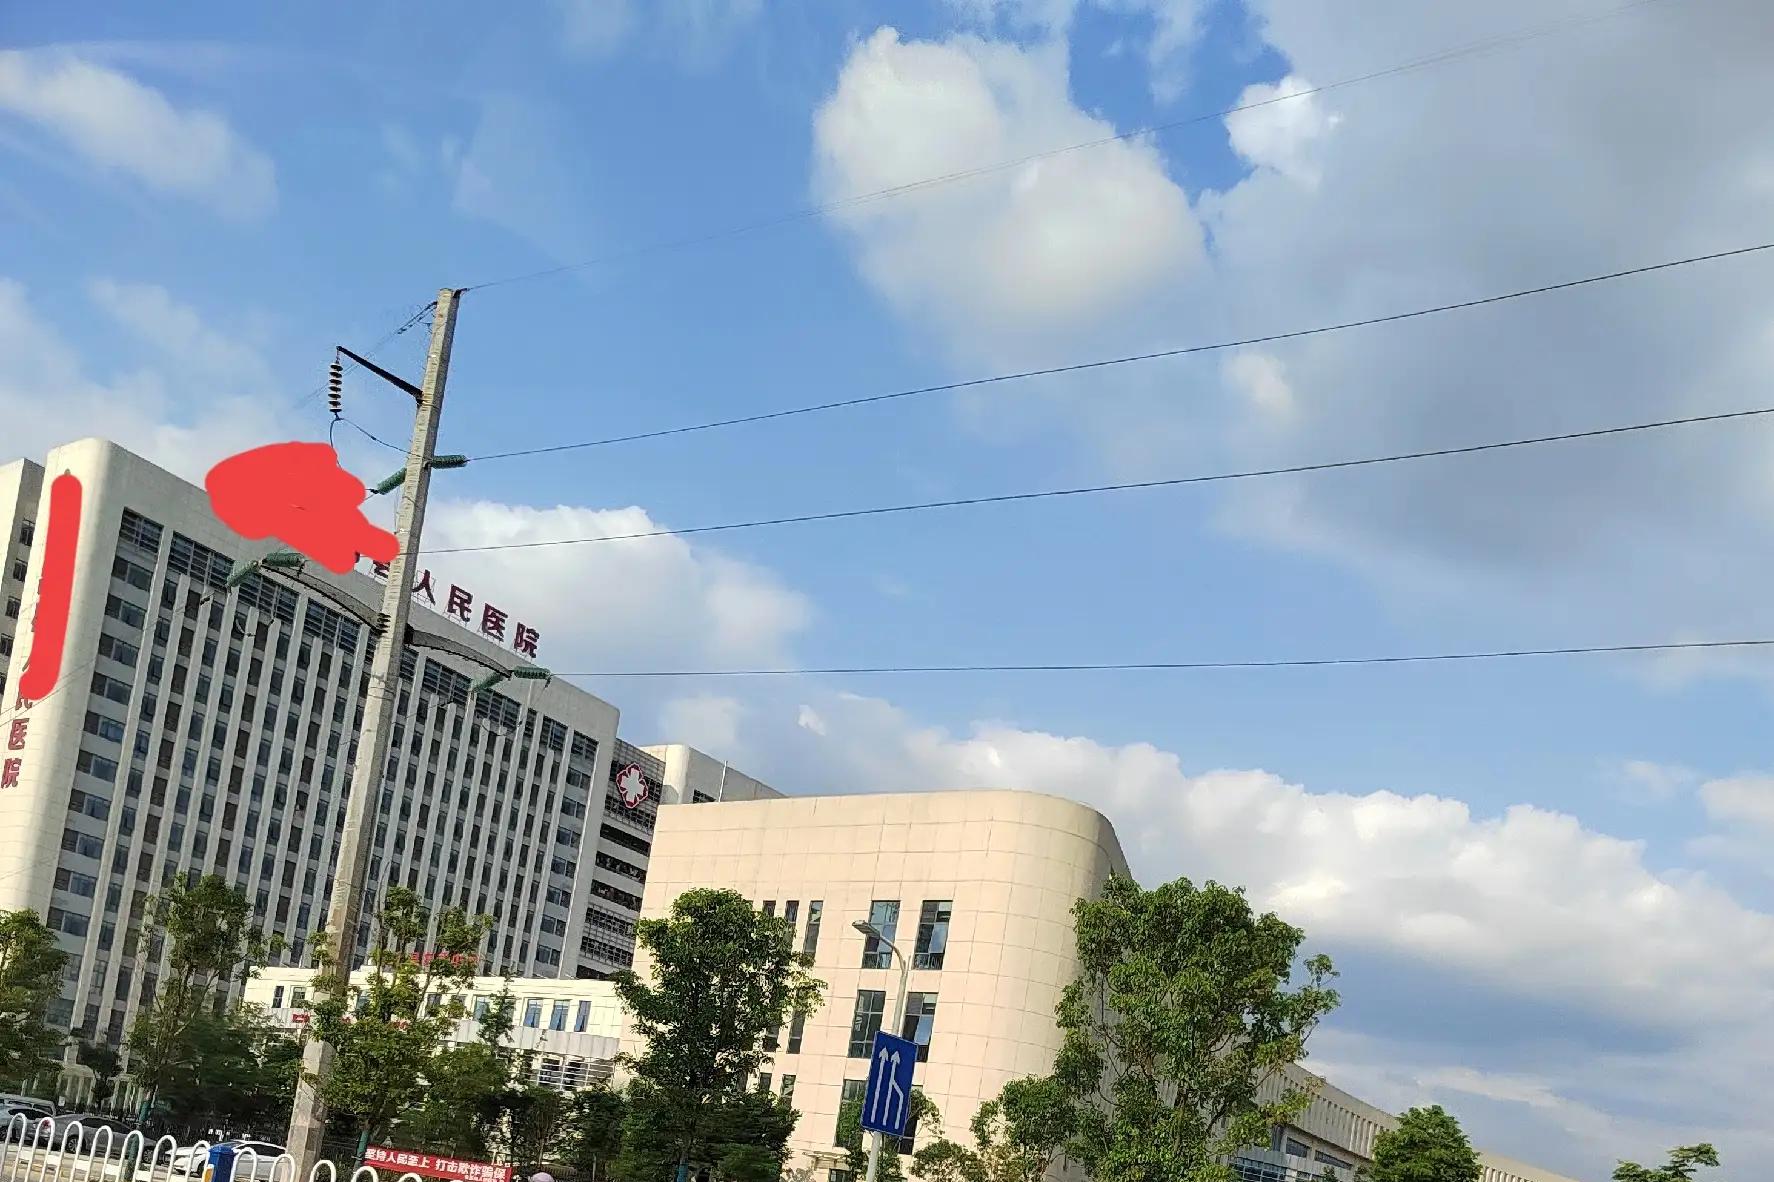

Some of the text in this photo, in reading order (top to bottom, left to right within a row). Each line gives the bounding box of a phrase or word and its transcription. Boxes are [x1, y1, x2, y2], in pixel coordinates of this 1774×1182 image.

[364, 1148, 431, 1169] 坚持人民至上
[435, 1158, 507, 1181] 打击欺诈骗保
